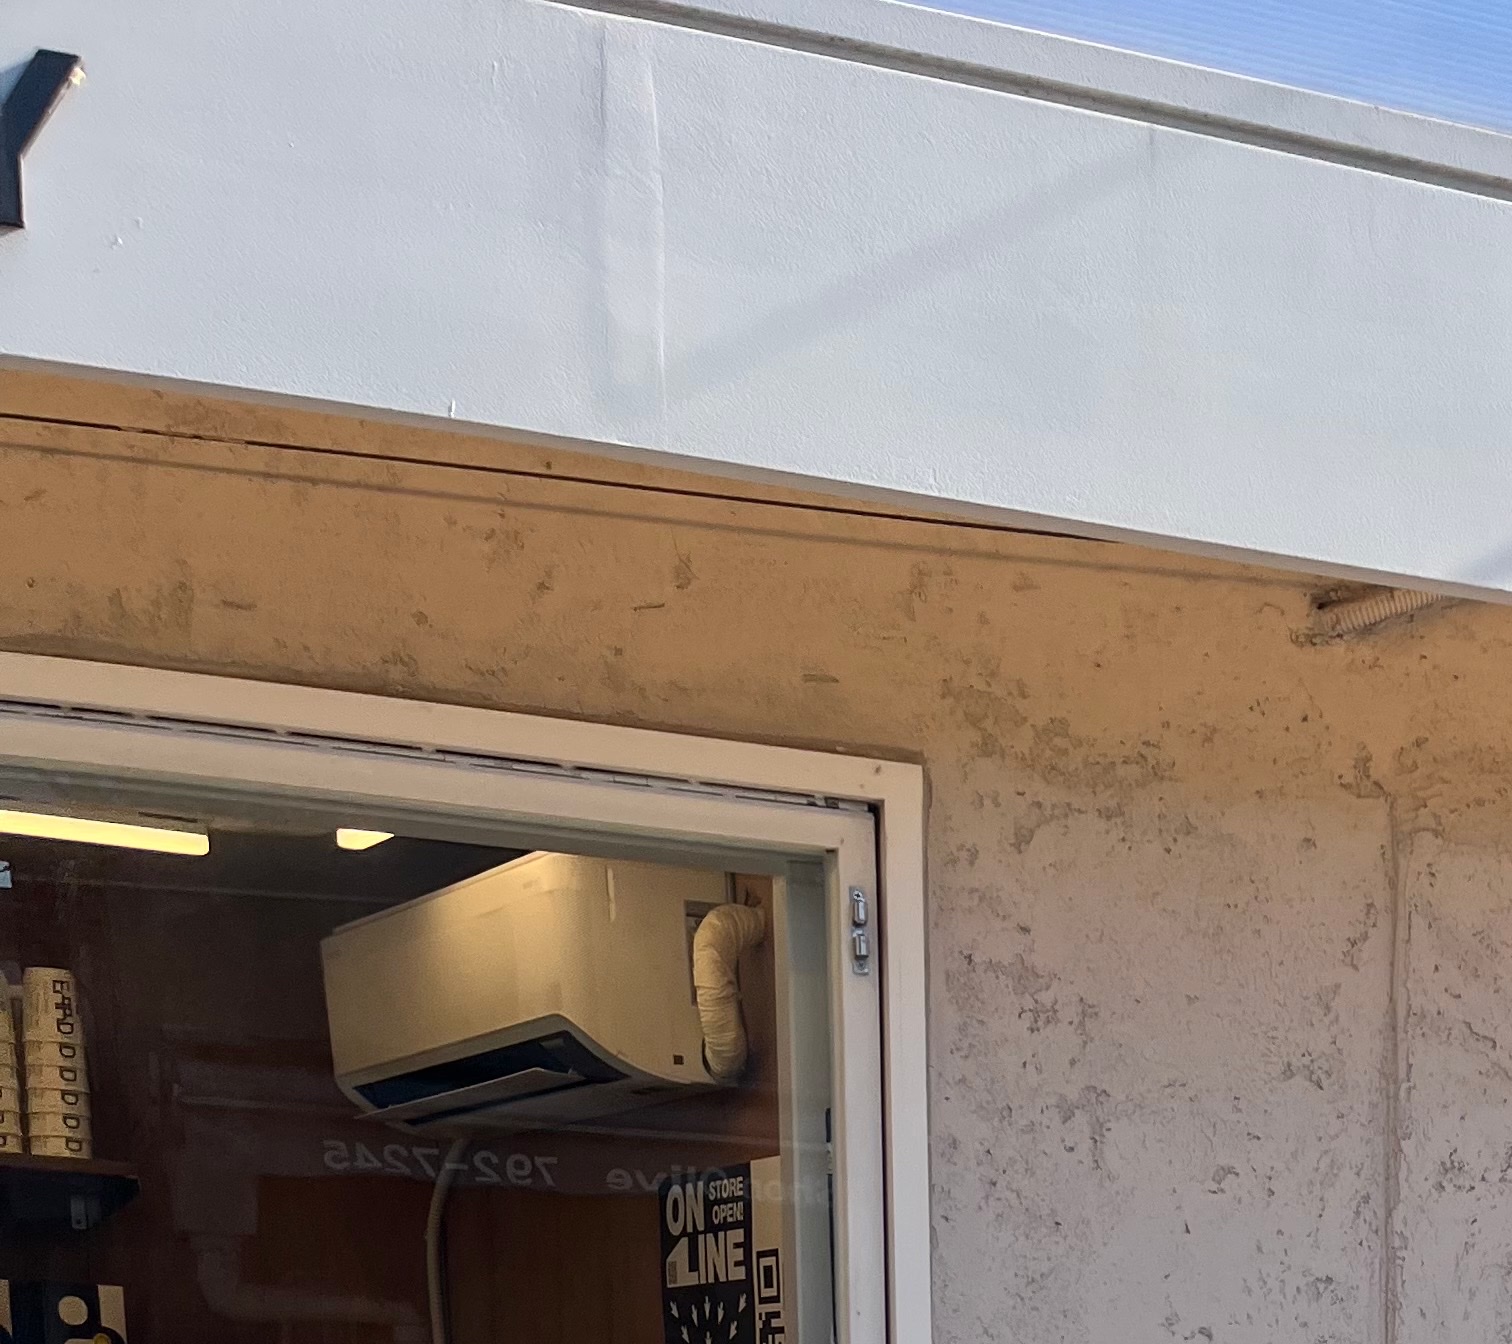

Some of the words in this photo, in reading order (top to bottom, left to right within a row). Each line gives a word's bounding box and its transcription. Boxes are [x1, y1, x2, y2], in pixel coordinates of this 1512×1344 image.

[708, 1176, 744, 1200] STORE
[666, 1181, 705, 1236] ON
[712, 1201, 744, 1224] OPEN!
[666, 1228, 746, 1288] LINE
